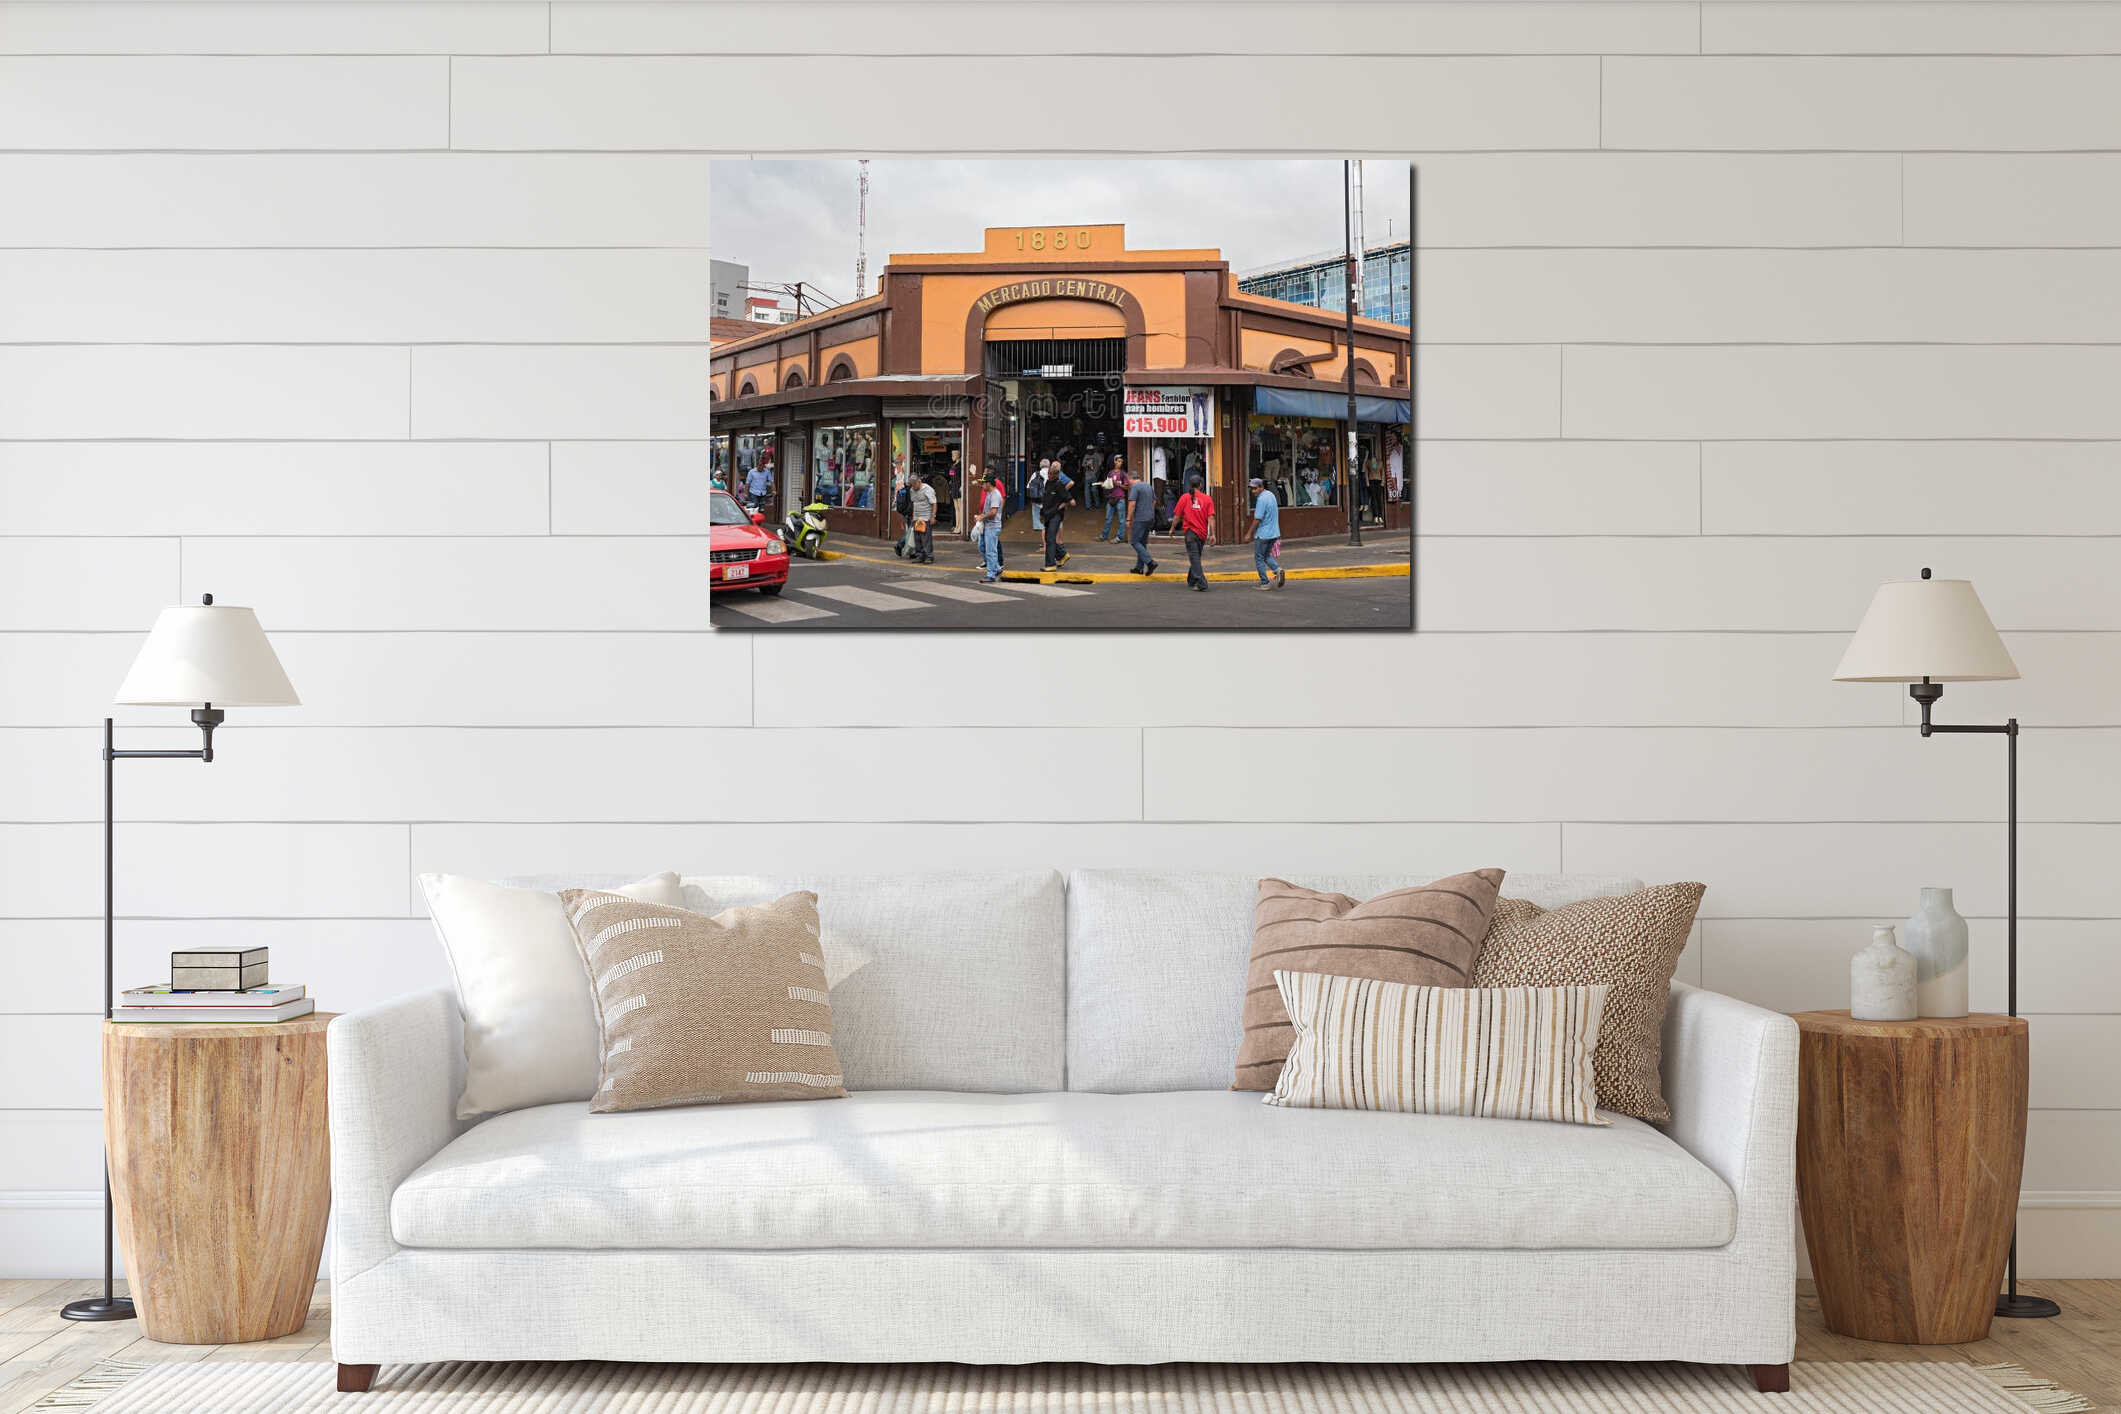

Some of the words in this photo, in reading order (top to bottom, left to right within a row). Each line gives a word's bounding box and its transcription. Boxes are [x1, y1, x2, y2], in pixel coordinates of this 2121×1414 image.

[1016, 231, 1091, 251] 1880
[977, 281, 1050, 313] MERCADO
[1056, 280, 1125, 307] CENTRAL
[1126, 390, 1161, 403] JEANS
[1125, 404, 1145, 413] para
[1146, 404, 1185, 413] hombres
